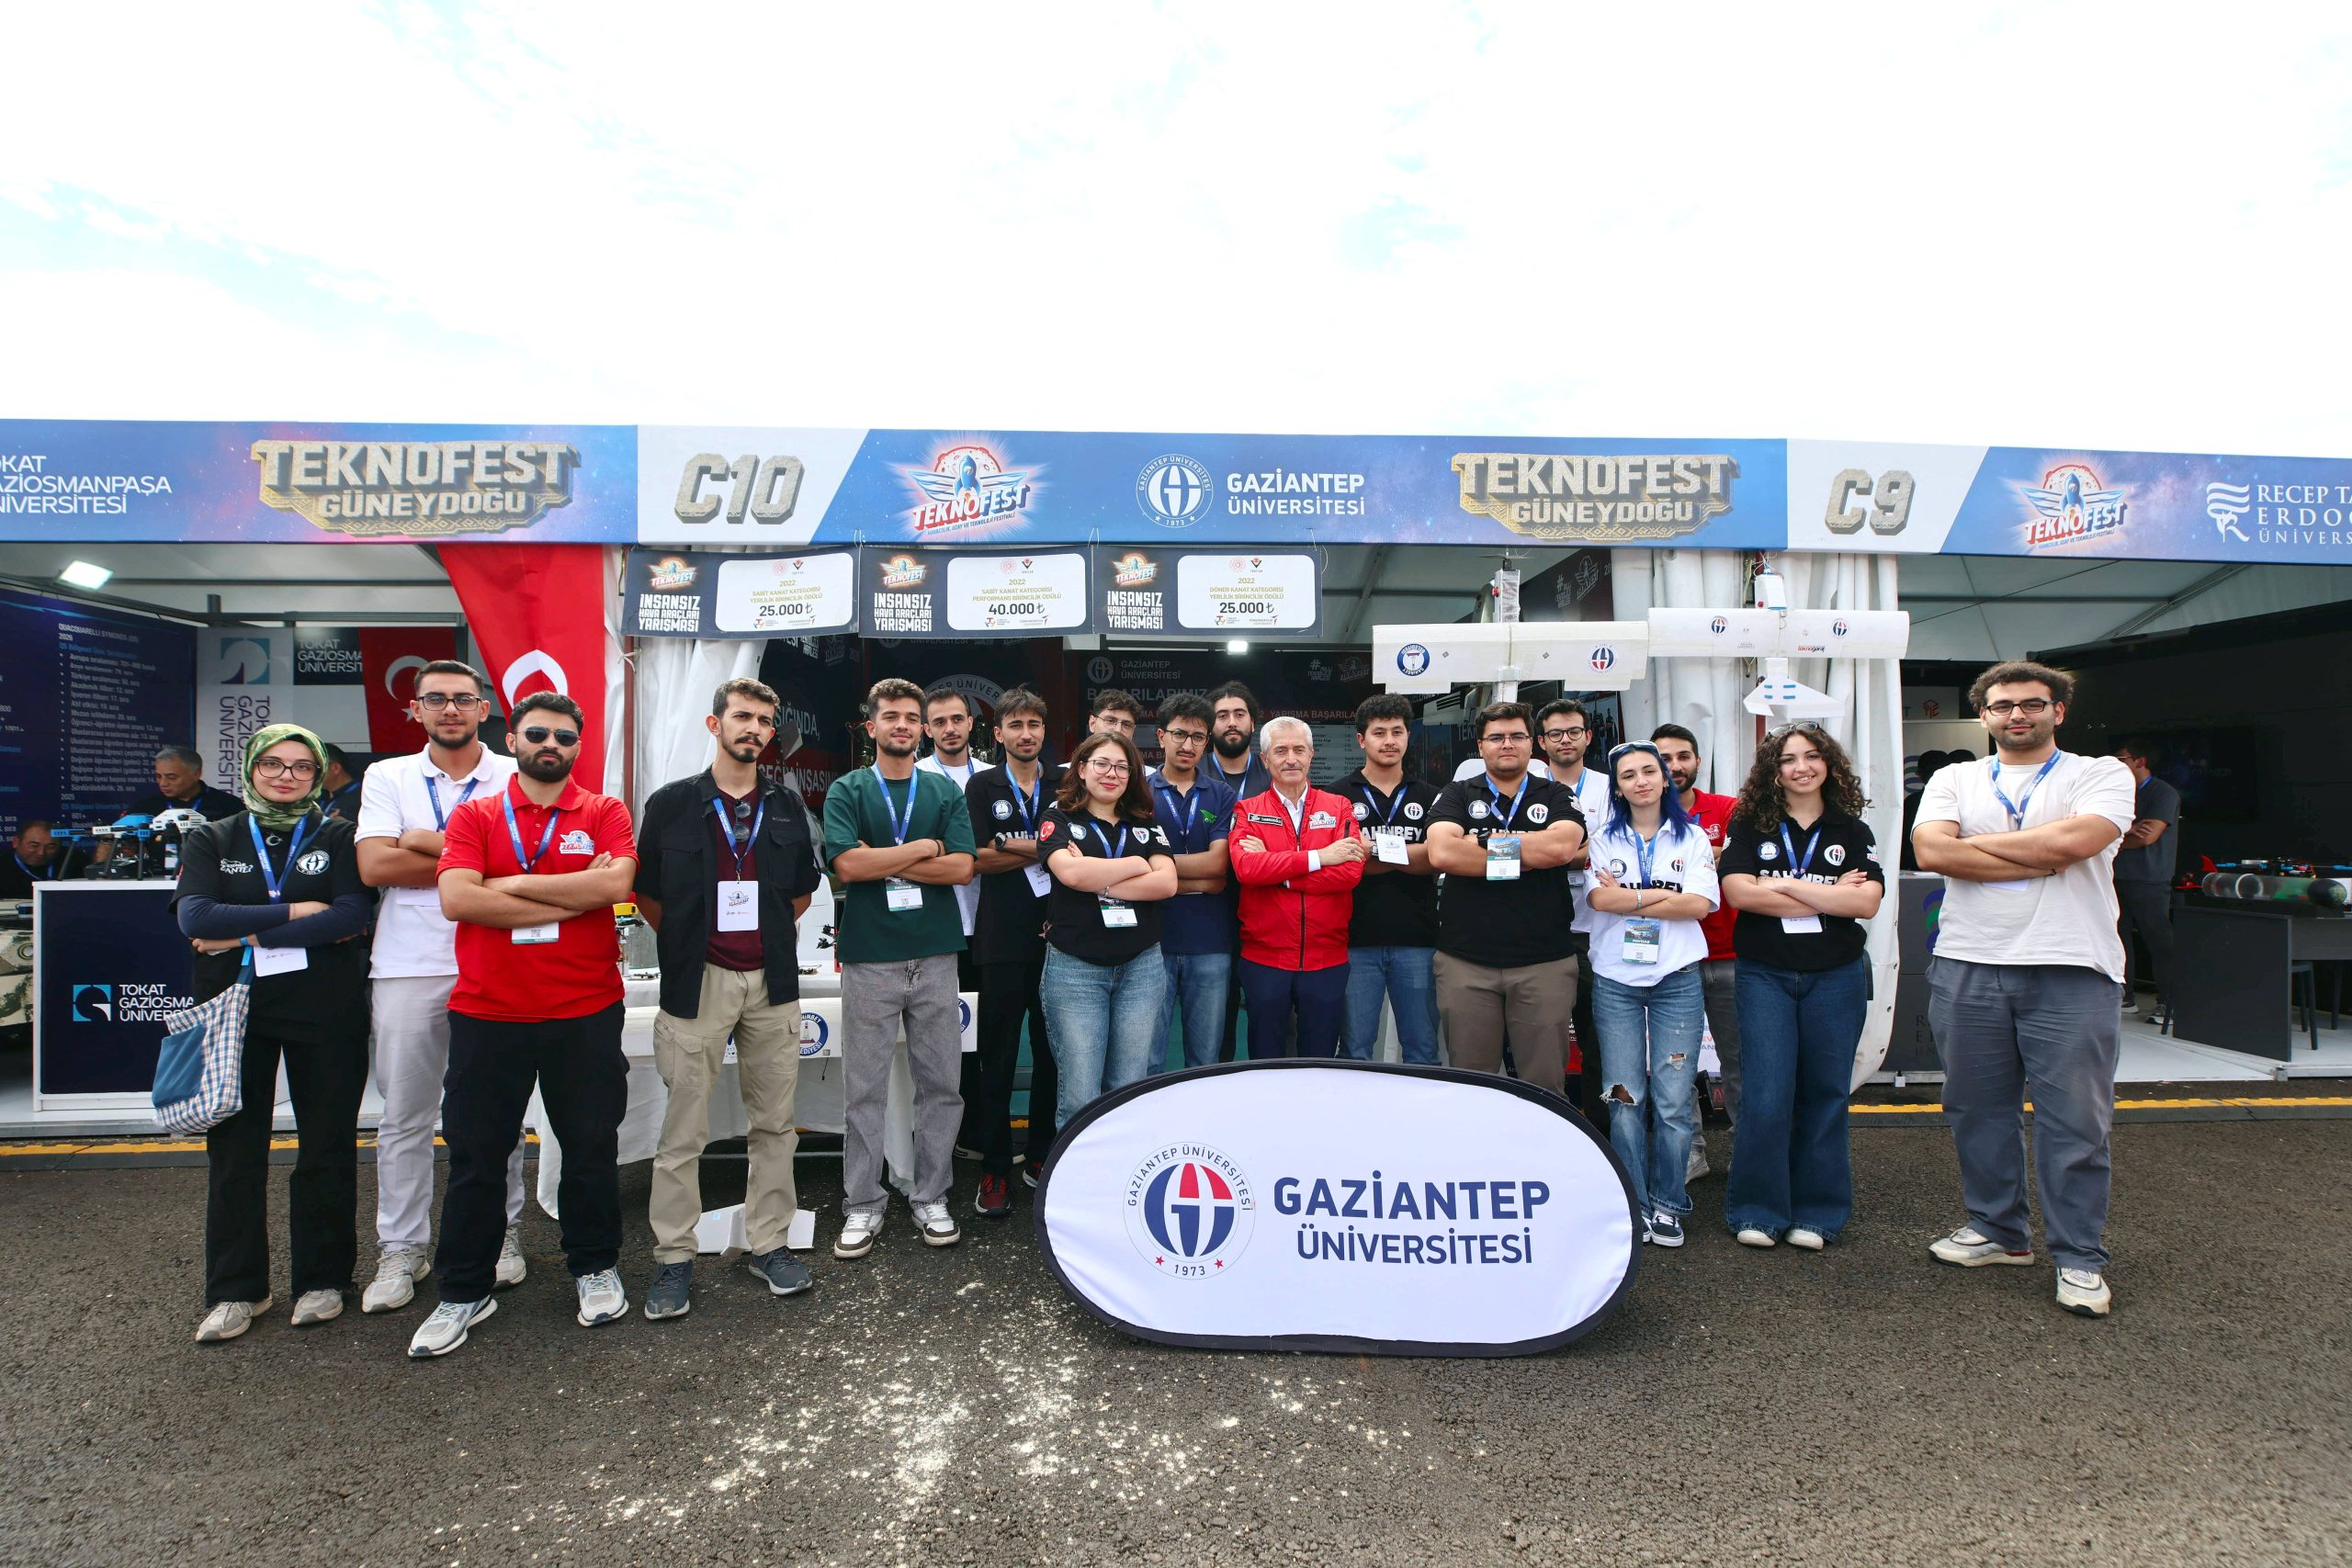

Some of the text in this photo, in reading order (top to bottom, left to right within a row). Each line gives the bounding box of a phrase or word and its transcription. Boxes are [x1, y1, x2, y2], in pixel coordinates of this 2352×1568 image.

[0, 455, 47, 473] KAT
[254, 441, 579, 487] TEKNOFEST
[1139, 457, 1168, 491] GAZİANTEP
[1227, 468, 1365, 493] GAZİANTEP
[1454, 453, 1738, 497] TEKNOFEST
[0, 473, 173, 496] ZİOSMANPAŞA
[674, 453, 805, 525] C10
[1824, 468, 1917, 536] C9
[2256, 484, 2329, 503] RECEP
[318, 488, 527, 520] GÜNEYDOĞU
[912, 484, 1030, 530] TEKNOFEST
[1227, 496, 1365, 516] ÜNİVERSİTESİ
[1512, 499, 1694, 525] GÜNEYDOĞU
[993, 513, 1015, 522] FESTİVALİ
[2025, 502, 2128, 545] TEKNOFEST
[2256, 507, 2352, 526] ERDO
[650, 572, 696, 586] TEKNOFEST
[883, 570, 926, 584] TEKNOFEST
[1115, 568, 1158, 584] TEKNOFEST
[639, 593, 701, 610] İNSANSIZ
[874, 592, 933, 609] İNSANSIZ
[1107, 591, 1163, 606] İNSANSIZ
[639, 608, 660, 618] HAVA
[759, 603, 803, 616] 25.000
[874, 608, 894, 617] HAVA
[989, 603, 1035, 615] 40.000
[1107, 606, 1126, 615] HAVA
[1219, 602, 1264, 613] 25.000
[639, 617, 699, 632] YARIŞMASI
[874, 617, 933, 632] YARIŞMASI
[1107, 615, 1163, 629] YARIŞMASI
[1121, 659, 1171, 670] GAZİANTEP
[1121, 670, 1182, 680] ÜNİVERSİTESİ
[119, 984, 167, 996] TOKAT
[1128, 1144, 1253, 1211] GAZİANTEP ÜNİVERSİTESİ
[1273, 1169, 1551, 1221] GAZİANTEP
[1297, 1223, 1532, 1265] ÜNİVERSİTESİ
[1174, 1264, 1205, 1276] 1973
